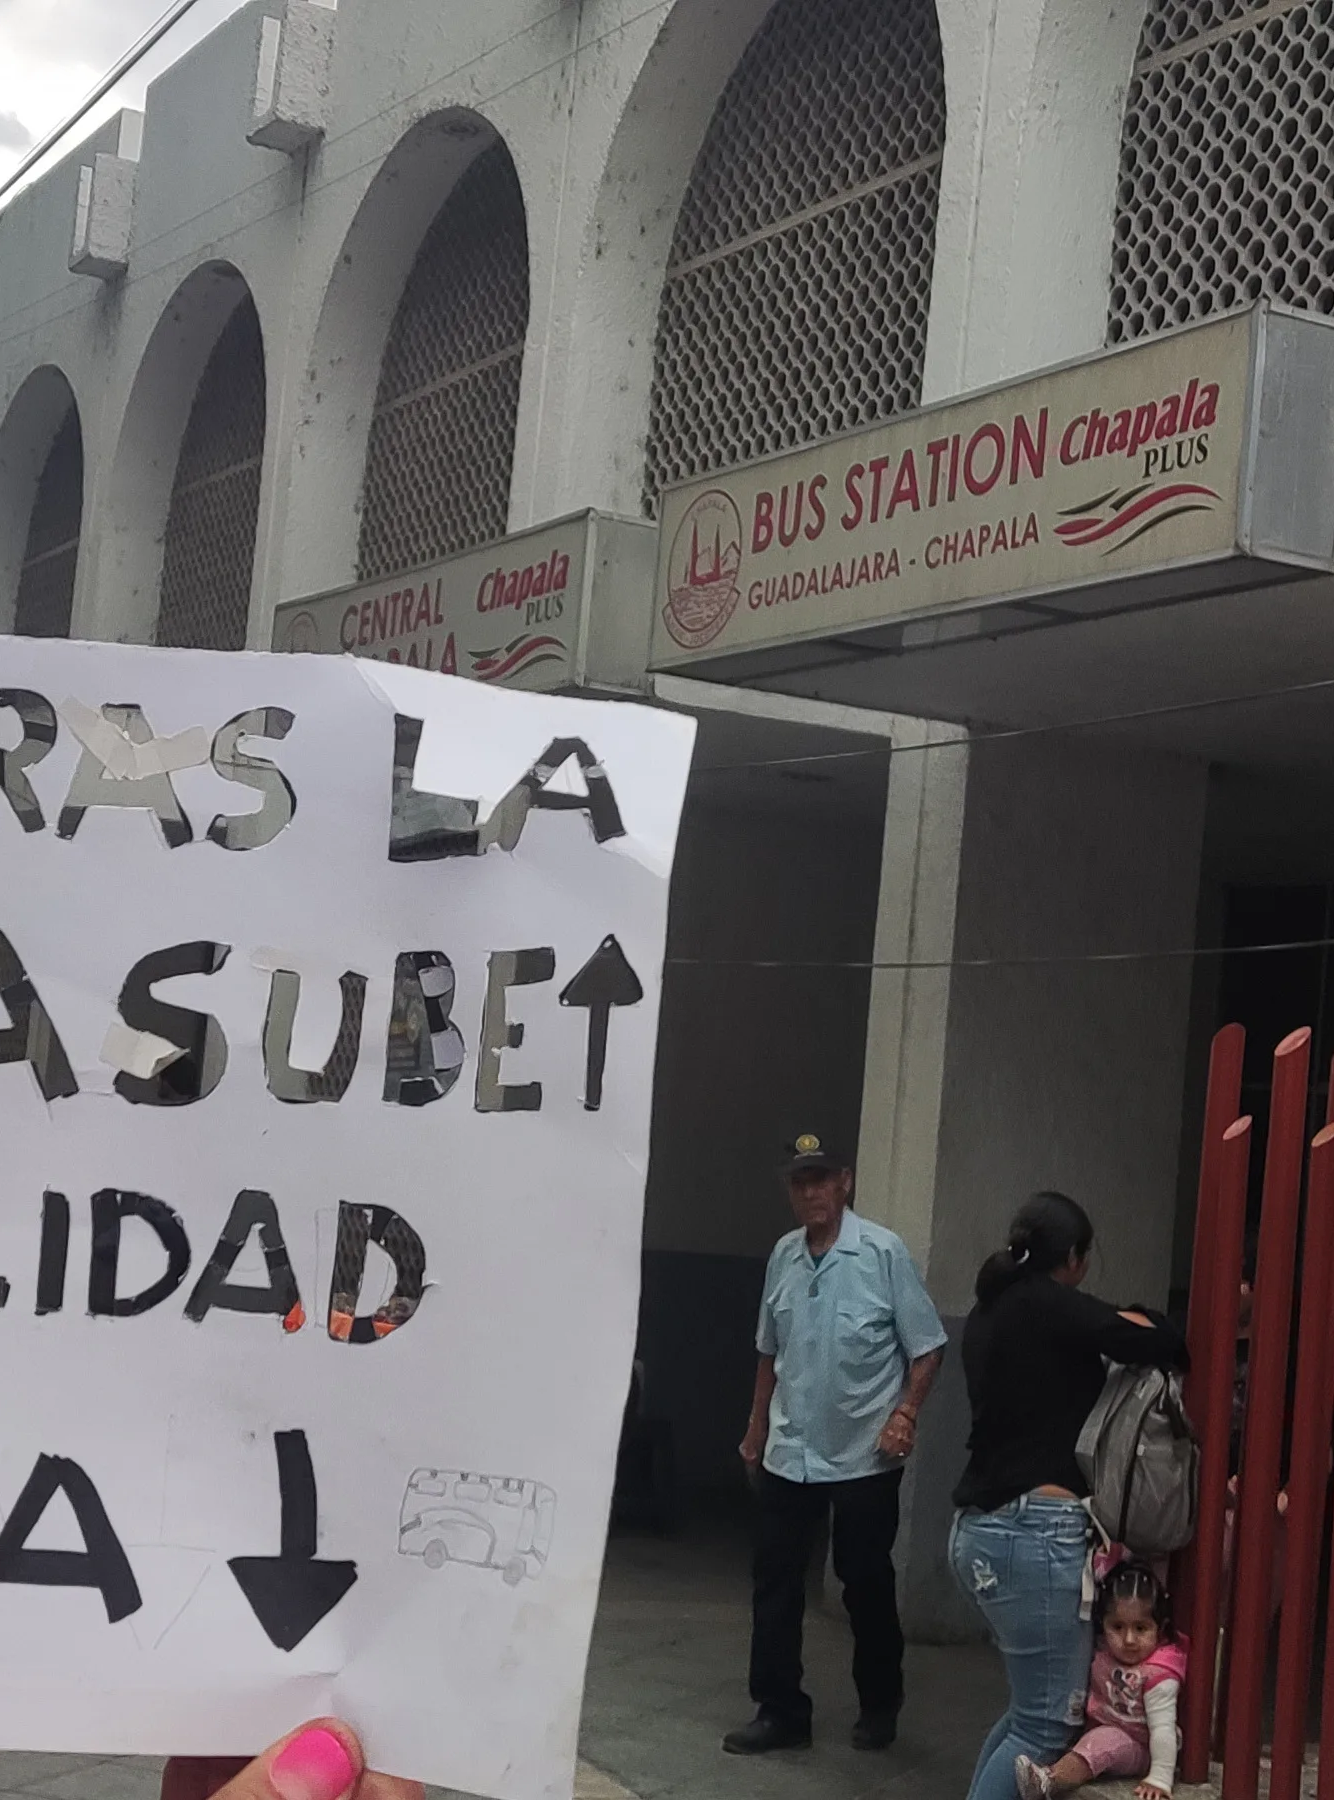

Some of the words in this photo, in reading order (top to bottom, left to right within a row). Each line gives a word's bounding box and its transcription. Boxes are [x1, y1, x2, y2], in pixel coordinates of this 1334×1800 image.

[1060, 378, 1220, 466] Chapala
[1142, 433, 1209, 478] PLUS
[752, 474, 828, 554] BUS
[841, 406, 1049, 531] STATION
[476, 550, 570, 613] Chapala
[748, 549, 900, 610] GUADALAJARA
[924, 511, 1040, 570] CHAPALA
[339, 577, 444, 651] CENTRAL
[525, 594, 564, 626] PLUS
[388, 712, 624, 864] LA
[100, 940, 559, 1114] SUBE
